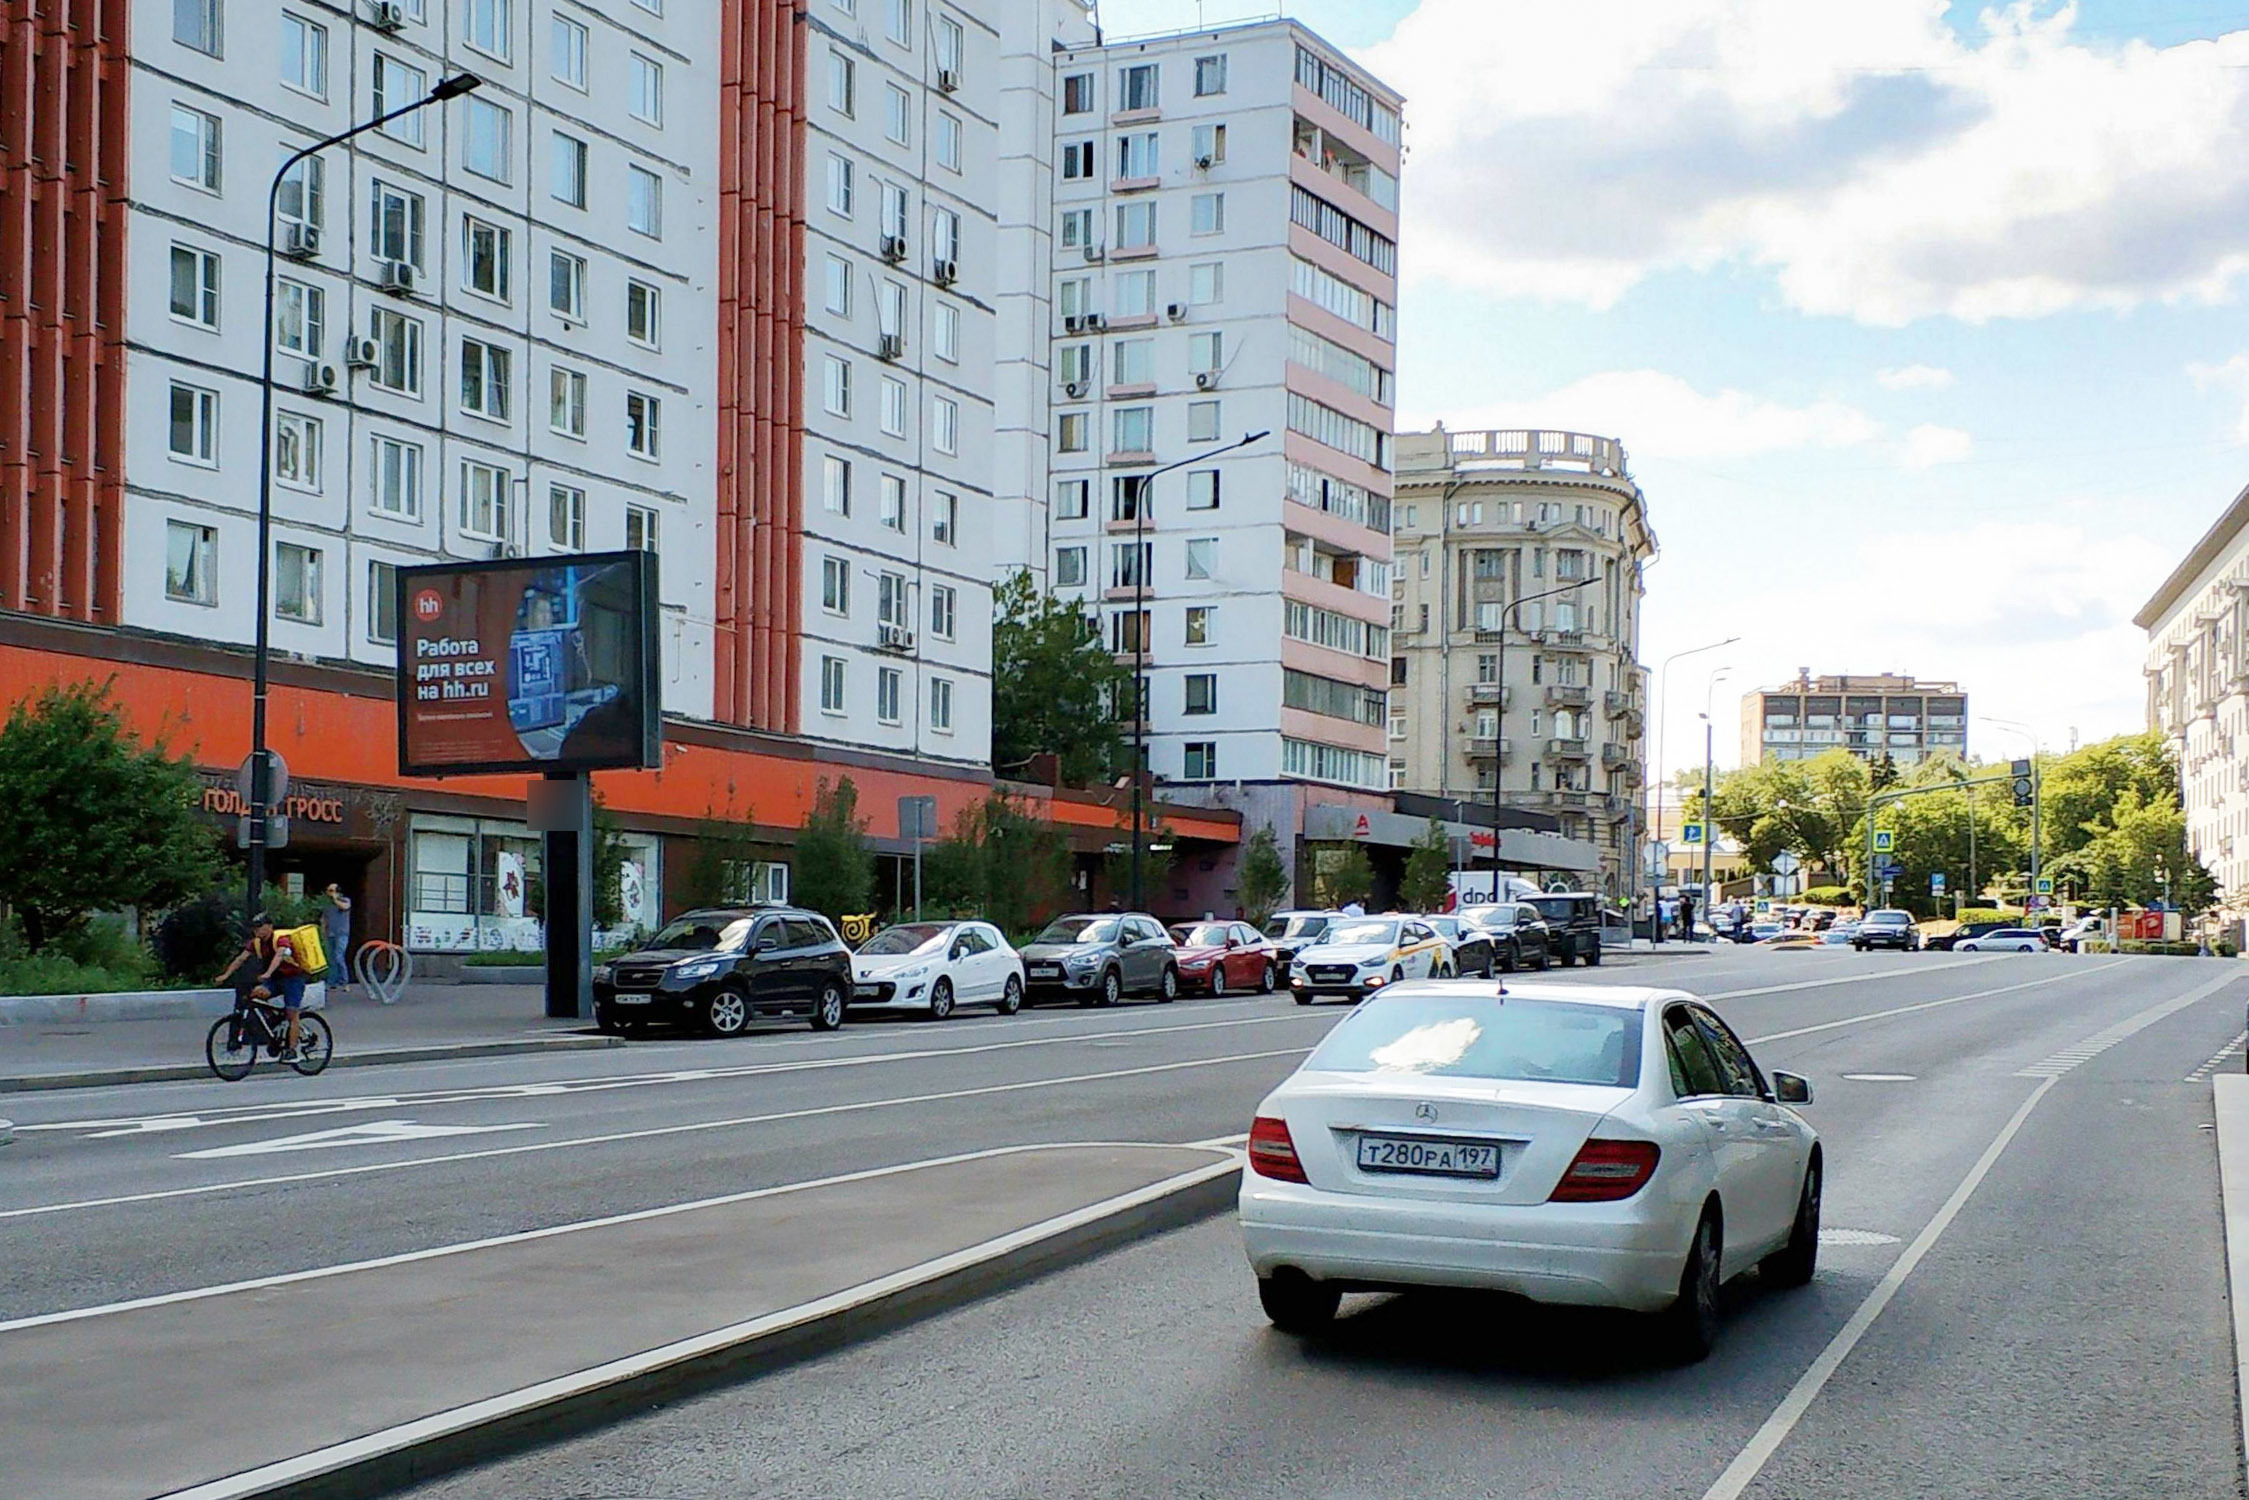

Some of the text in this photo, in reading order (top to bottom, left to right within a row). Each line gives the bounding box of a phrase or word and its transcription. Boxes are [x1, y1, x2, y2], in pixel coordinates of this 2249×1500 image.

[420, 597, 439, 614] hh
[417, 638, 479, 657] Работа
[417, 660, 496, 681] для всех
[417, 681, 488, 700] на hh.ru
[286, 797, 343, 822] ГРОСС
[1459, 1147, 1490, 1165] 197
